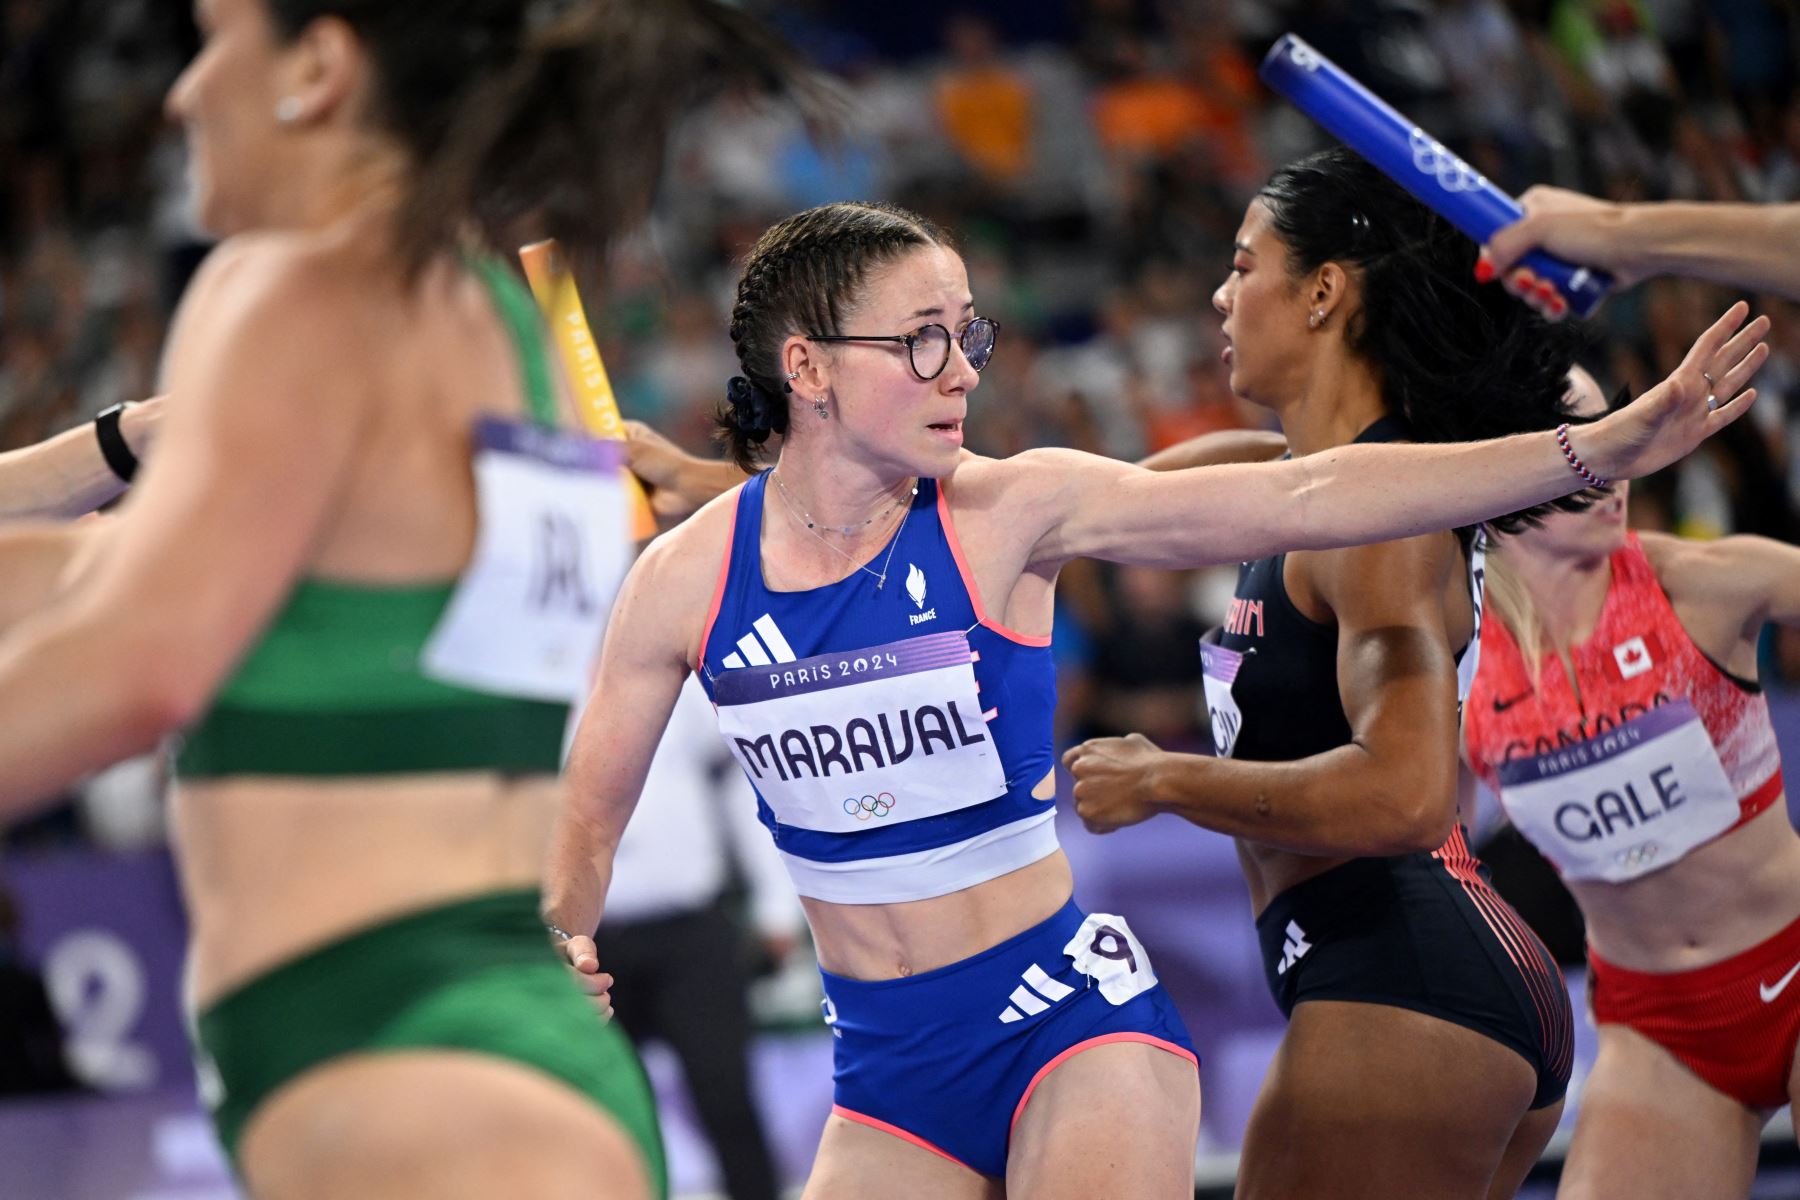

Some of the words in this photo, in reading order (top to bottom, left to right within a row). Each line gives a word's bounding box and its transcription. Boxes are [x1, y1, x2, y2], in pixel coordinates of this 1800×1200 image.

[909, 608, 937, 626] FRANCE
[839, 653, 898, 676] 2024
[734, 700, 986, 782] MARAVAL
[1554, 764, 1687, 843] GALE
[1089, 924, 1138, 975] 9
